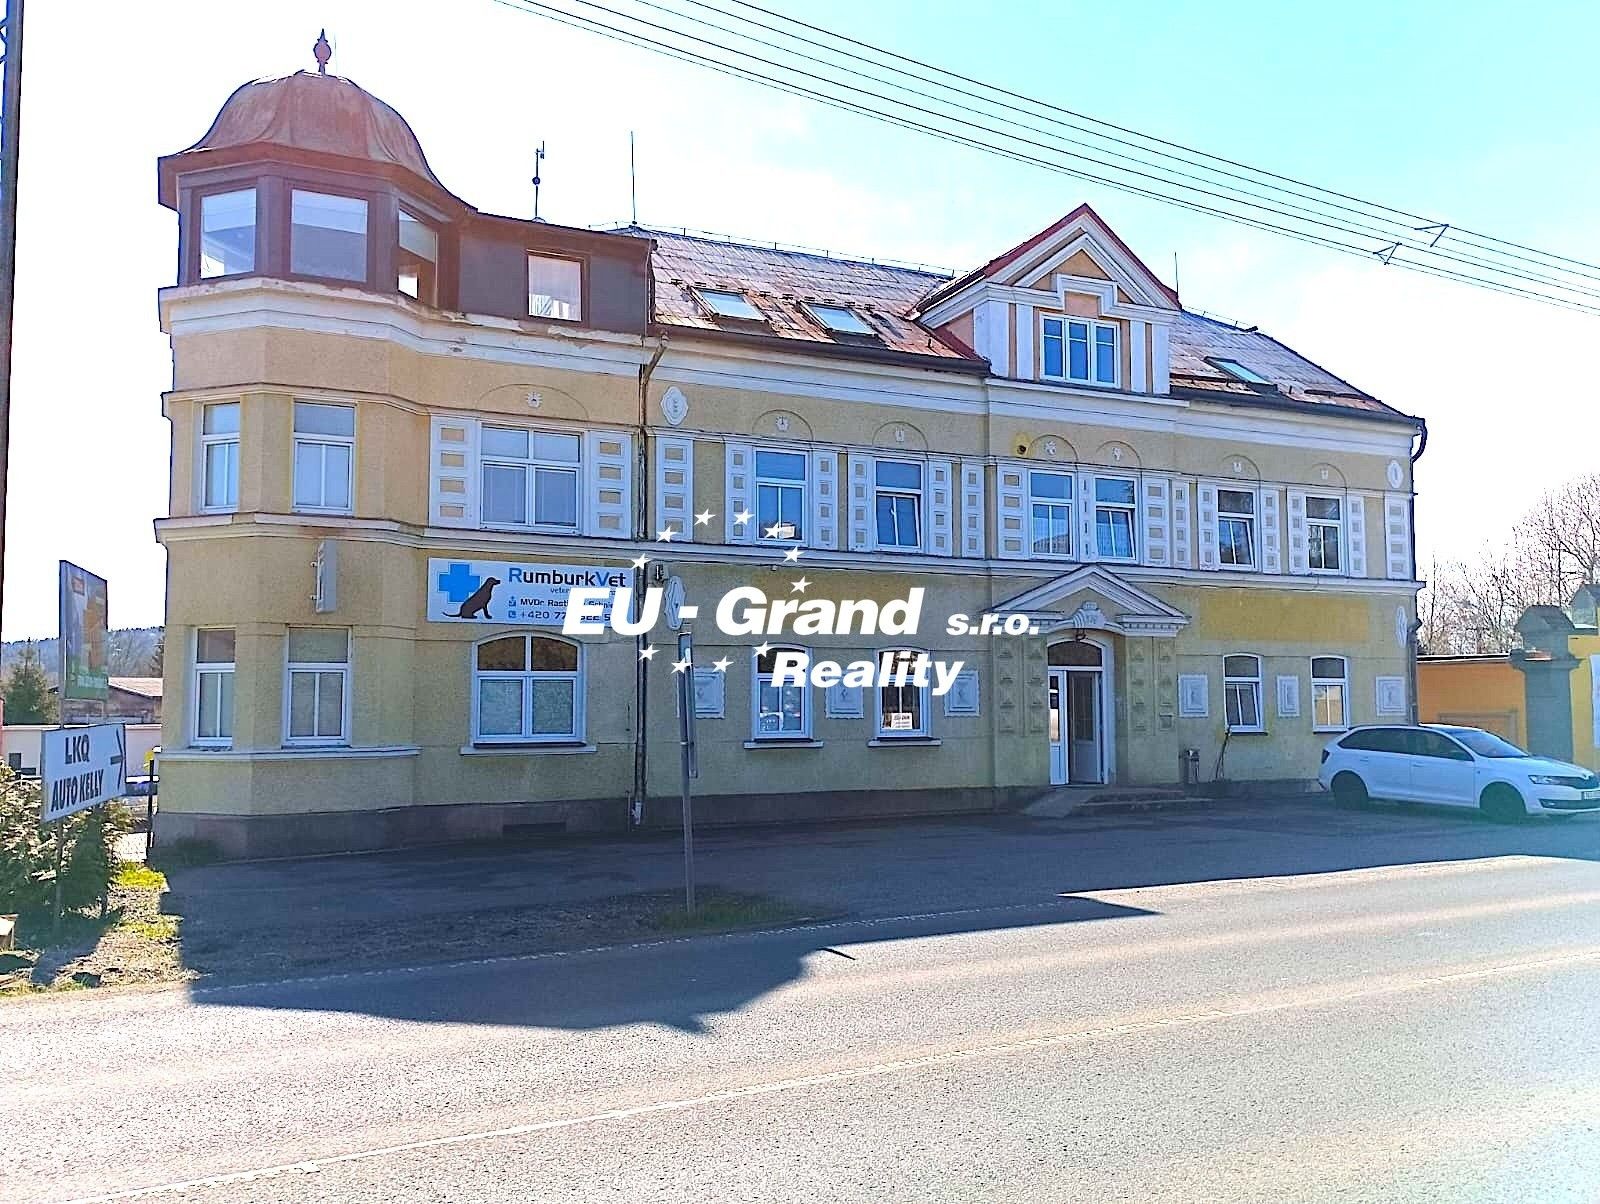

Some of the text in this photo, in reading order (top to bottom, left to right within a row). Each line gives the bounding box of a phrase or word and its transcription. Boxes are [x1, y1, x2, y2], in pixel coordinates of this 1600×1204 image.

[508, 567, 627, 588] RumburkVet
[65, 734, 90, 765] LKQ
[51, 769, 104, 812] AUTO KELLY
